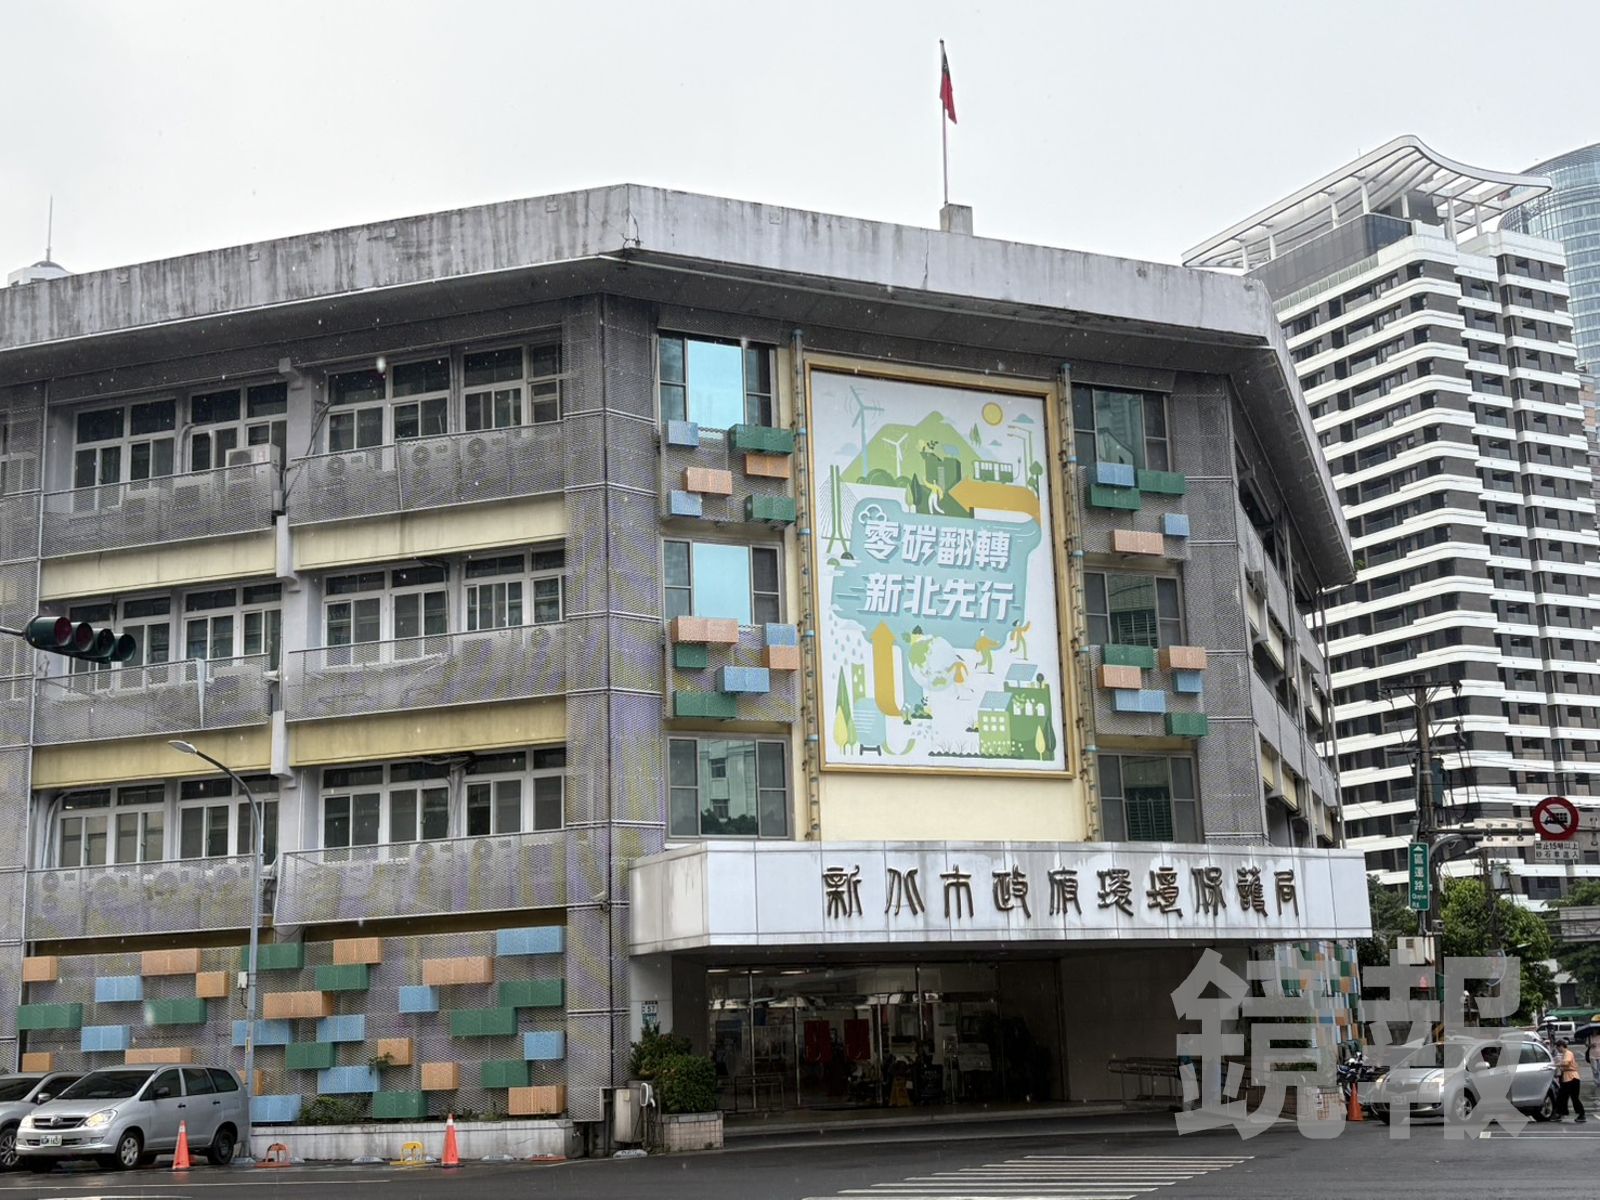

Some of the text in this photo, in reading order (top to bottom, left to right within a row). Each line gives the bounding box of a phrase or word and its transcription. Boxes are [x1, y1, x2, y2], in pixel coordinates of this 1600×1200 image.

[862, 518, 1011, 570] 零碳翻轉
[863, 571, 1015, 621] 新北先行
[822, 864, 1299, 919] 新北市政府環境保護局
